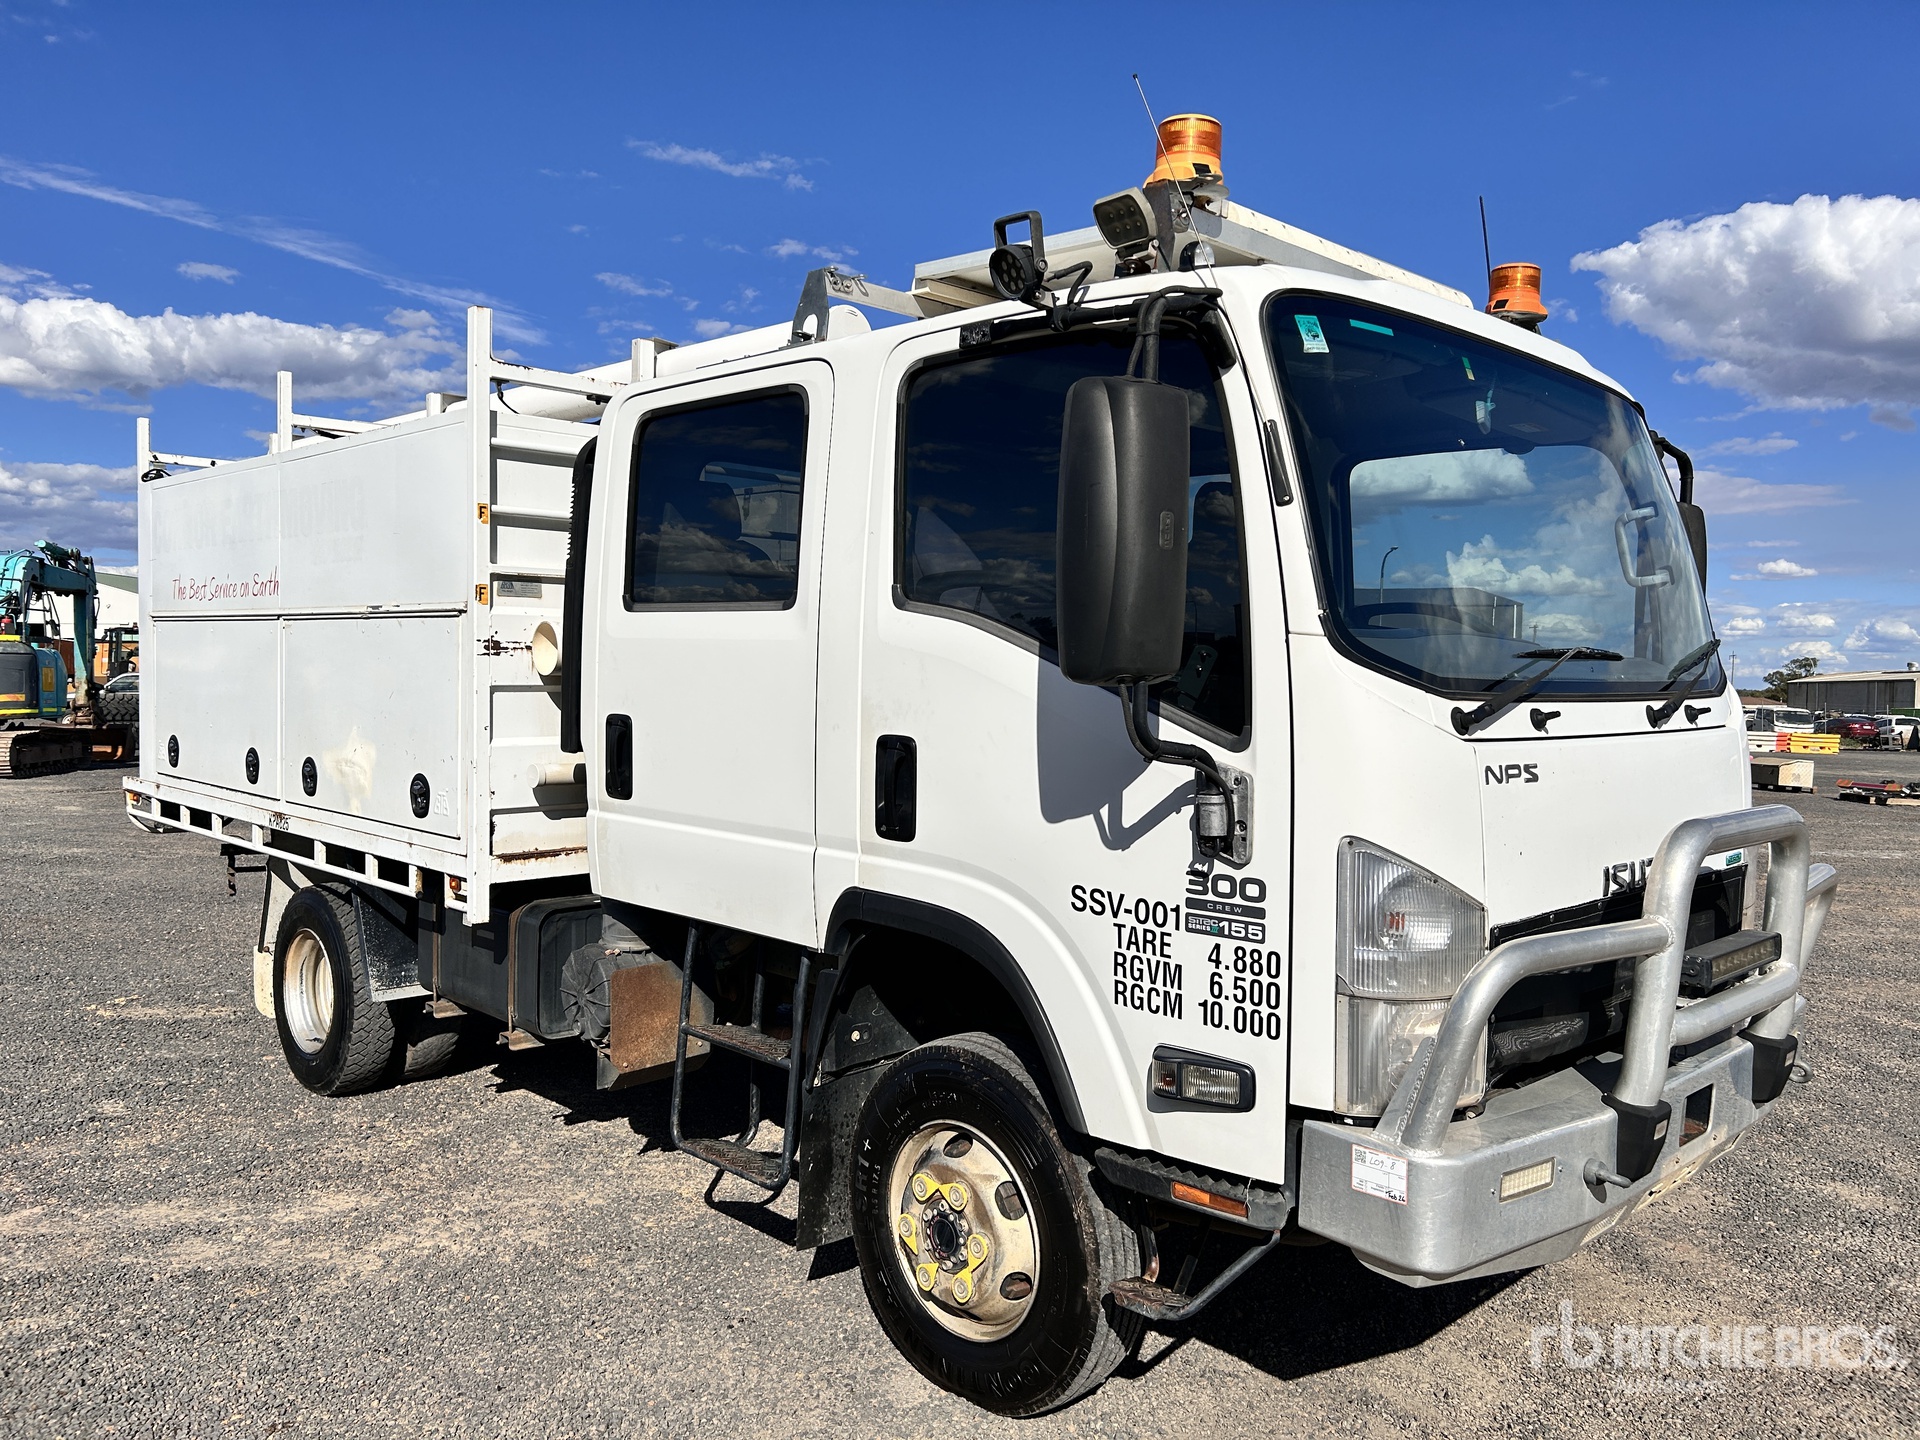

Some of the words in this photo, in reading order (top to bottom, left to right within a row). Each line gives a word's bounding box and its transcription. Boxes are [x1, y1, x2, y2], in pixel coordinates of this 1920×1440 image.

[172, 573, 186, 600] The
[189, 576, 208, 601] Best
[208, 573, 238, 601] Service
[240, 581, 250, 598] on
[252, 565, 280, 597] Earth
[1484, 763, 1539, 785] NPS
[1185, 870, 1267, 903] 300
[1070, 884, 1181, 931] SSV-001
[1207, 903, 1243, 913] CREW
[1219, 920, 1263, 940] 155
[1113, 922, 1173, 959] TARE
[1207, 942, 1281, 979] 4.880
[1113, 951, 1183, 991] RGVM
[1209, 971, 1281, 1010] 6.500
[1113, 979, 1183, 1020] RGCM
[1198, 999, 1281, 1040] 10.000
